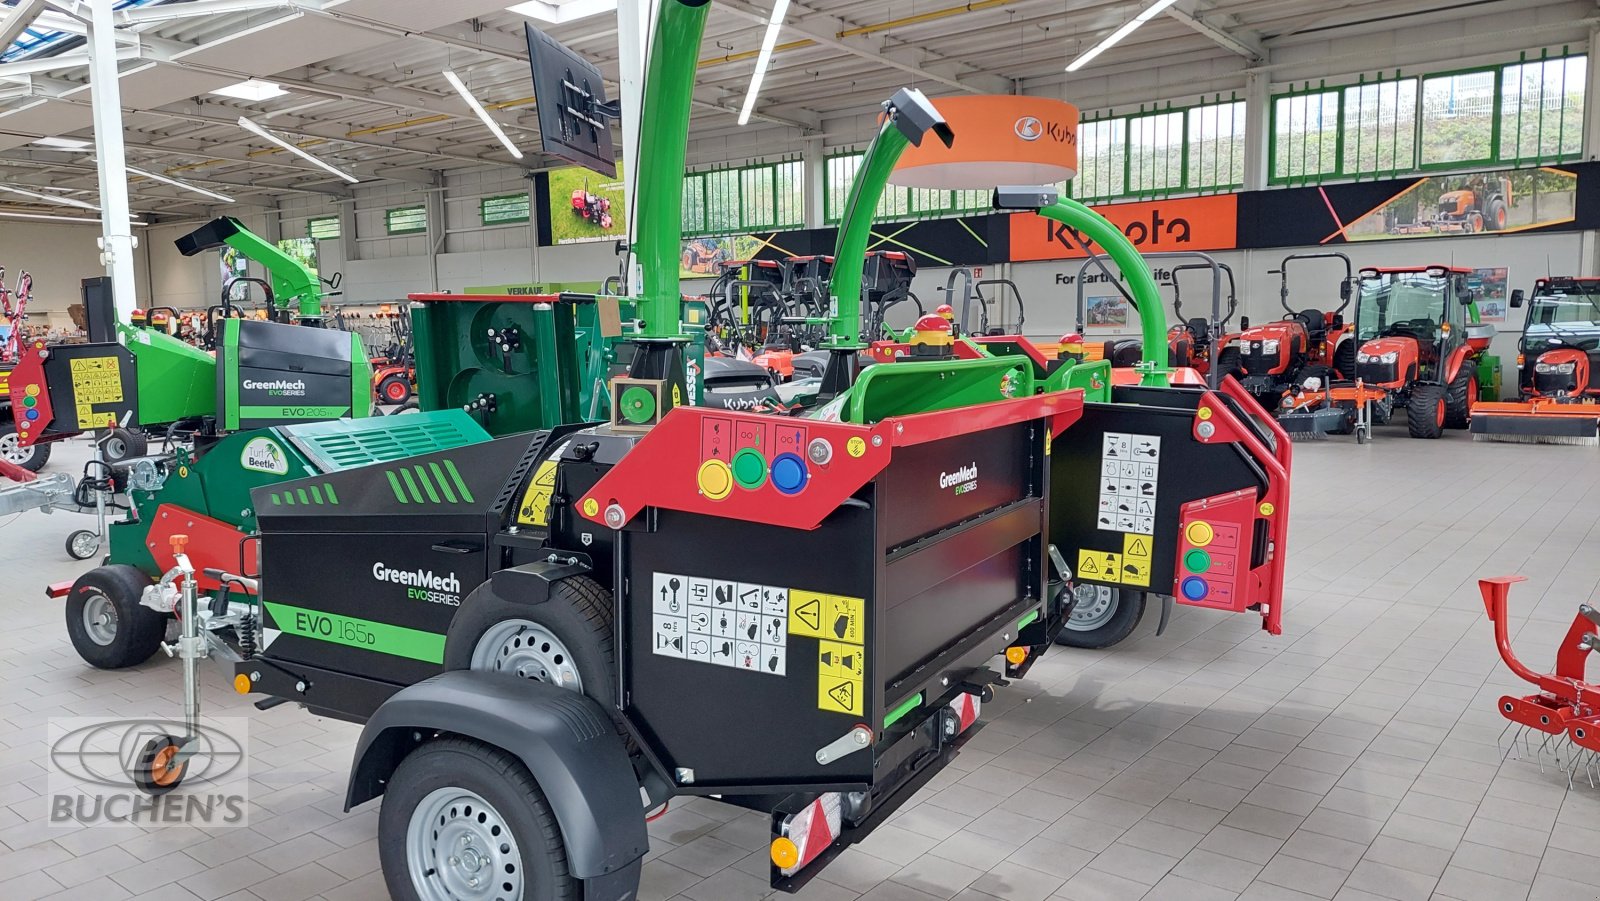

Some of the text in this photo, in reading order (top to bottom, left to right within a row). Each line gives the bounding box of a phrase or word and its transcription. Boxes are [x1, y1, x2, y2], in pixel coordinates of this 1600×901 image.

[1055, 273, 1076, 285] For
[1153, 268, 1171, 281] ife
[506, 286, 544, 296] VERKAUF
[242, 379, 306, 390] GreenMech
[282, 408, 306, 417] EVO
[1121, 441, 1127, 449] 8
[249, 446, 264, 459] Turf
[248, 457, 275, 470] Beetle
[939, 461, 978, 489] GreenMech
[955, 480, 978, 496] EVOSERIES
[372, 561, 461, 593] GreenMech
[407, 587, 461, 607] EVOSERIES
[295, 612, 333, 636] EVO
[663, 622, 672, 630] 8
